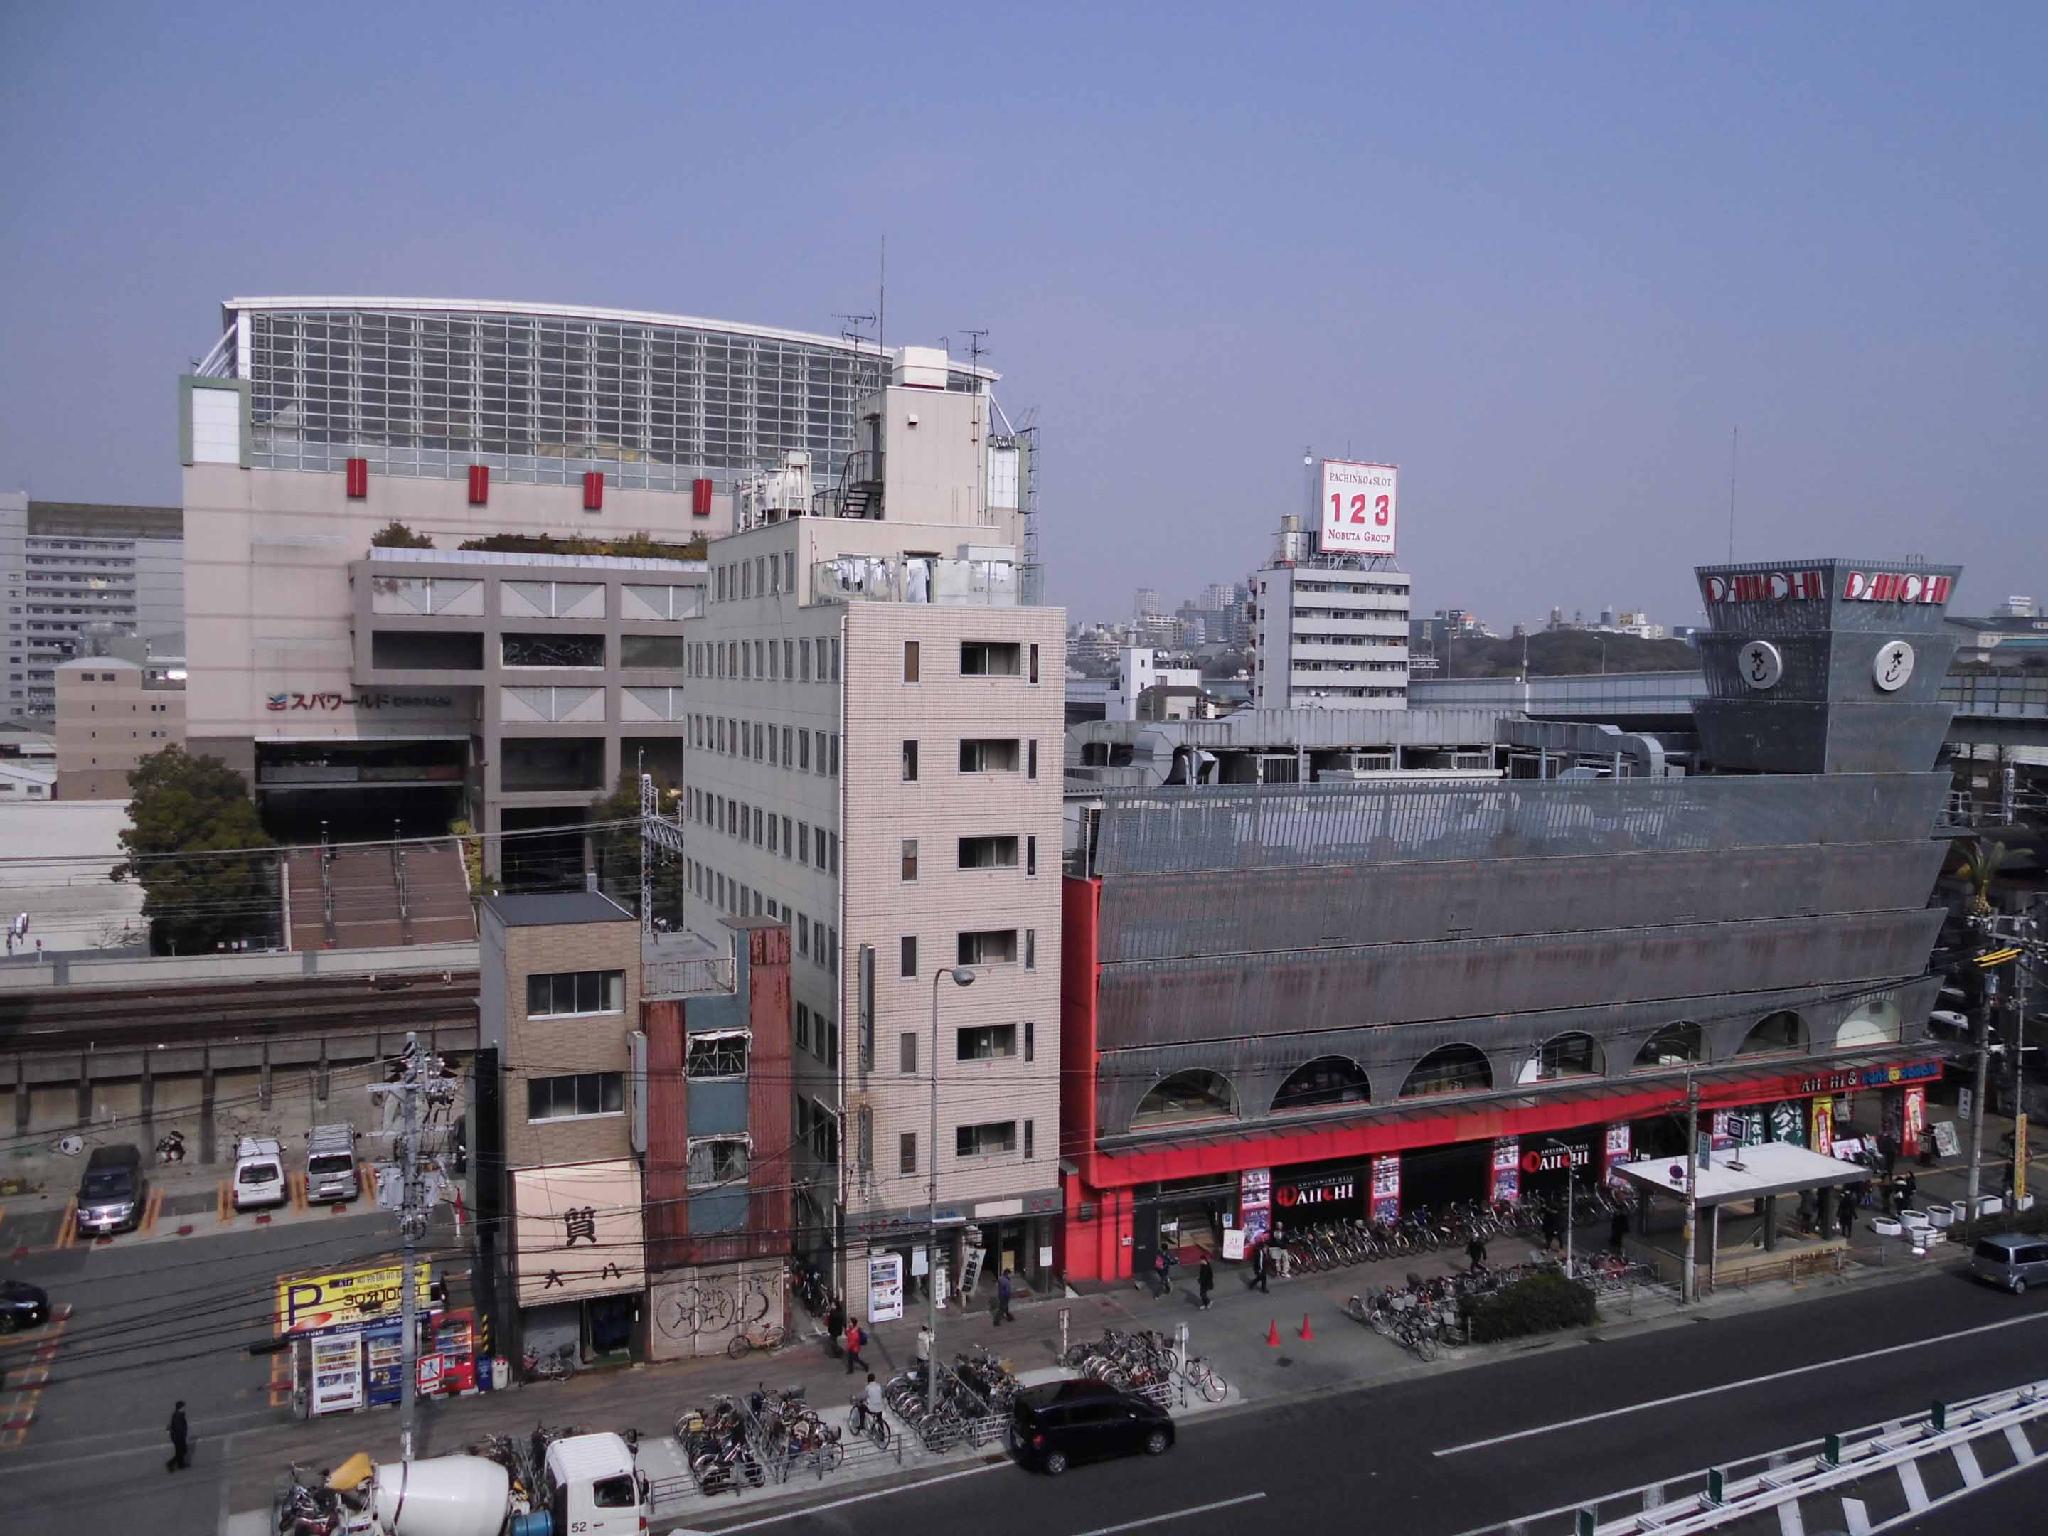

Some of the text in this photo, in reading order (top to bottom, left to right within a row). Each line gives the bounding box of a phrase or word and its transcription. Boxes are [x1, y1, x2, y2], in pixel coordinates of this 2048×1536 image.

[1330, 493, 1389, 526] 123
[1706, 571, 1825, 603] DAIICHI
[1843, 571, 1951, 603] DAIICHI
[291, 694, 389, 711] スパワールド
[1277, 1184, 1354, 1207] DAIICHI
[564, 1206, 597, 1246] 質
[287, 1283, 323, 1327] P
[571, 1521, 587, 1533] 52
